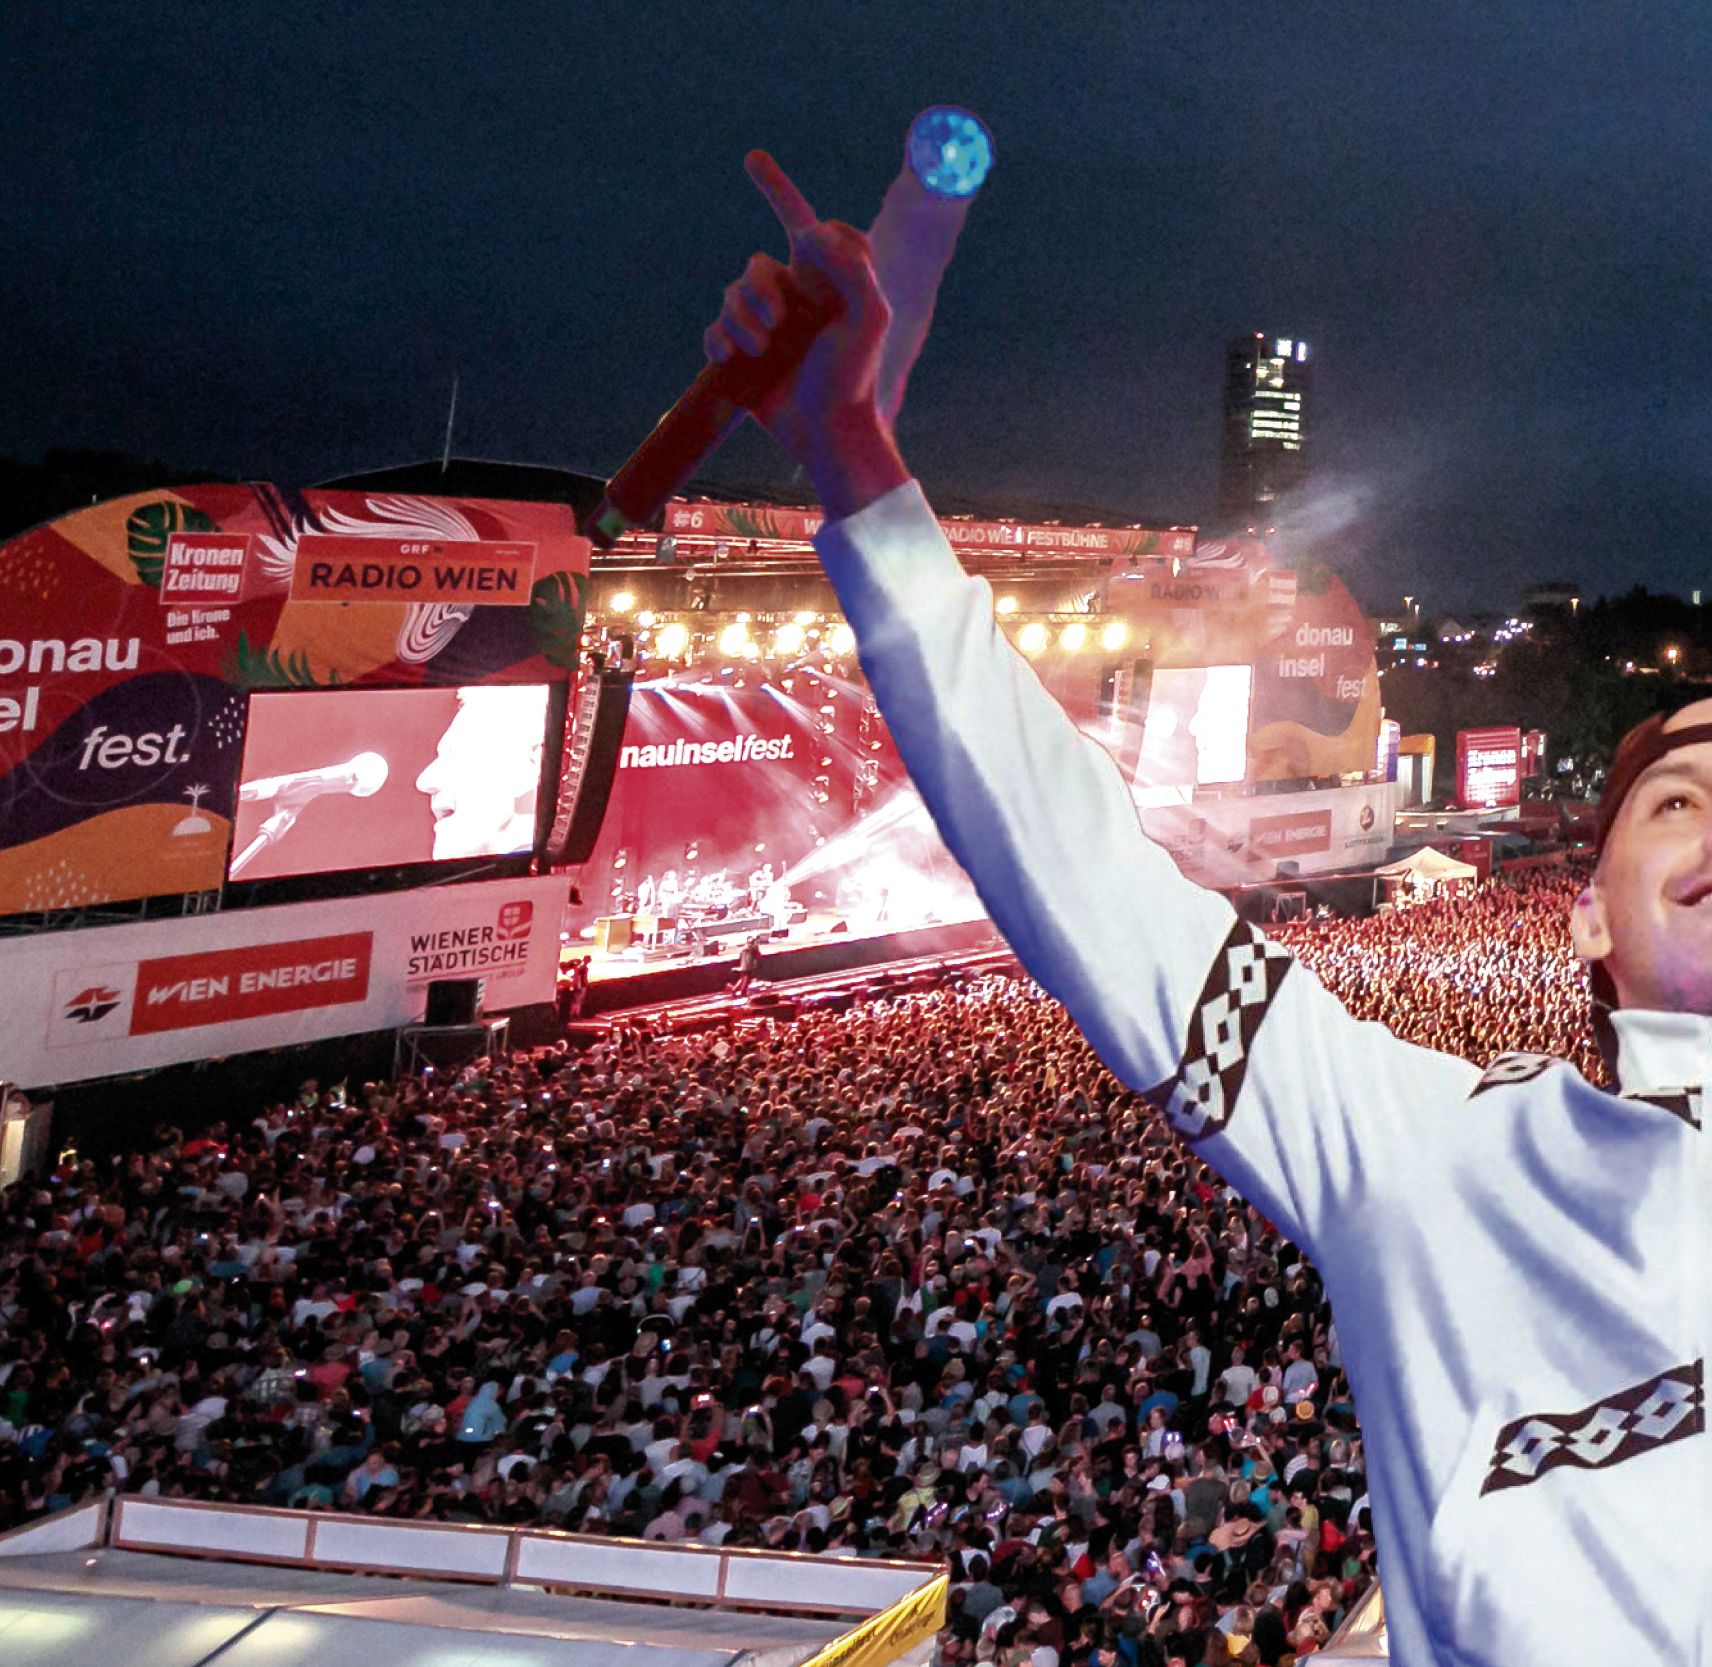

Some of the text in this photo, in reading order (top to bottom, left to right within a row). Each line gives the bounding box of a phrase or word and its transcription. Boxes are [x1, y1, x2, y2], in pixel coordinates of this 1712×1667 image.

[673, 511, 703, 528] #6
[1027, 530, 1108, 548] FESTBÜHNE
[170, 543, 244, 566] Kronen
[167, 568, 240, 593] Zeitung
[310, 562, 518, 591] RADIO WIEN
[167, 609, 231, 628] Die Krone
[166, 627, 193, 645] und
[1296, 622, 1354, 647] donau
[1279, 653, 1325, 678] insel
[79, 724, 191, 770] fest.
[411, 926, 494, 953] WIENER
[407, 941, 529, 975] STÄDTISCHE
[147, 958, 357, 1005] WIEN ENERGIE
